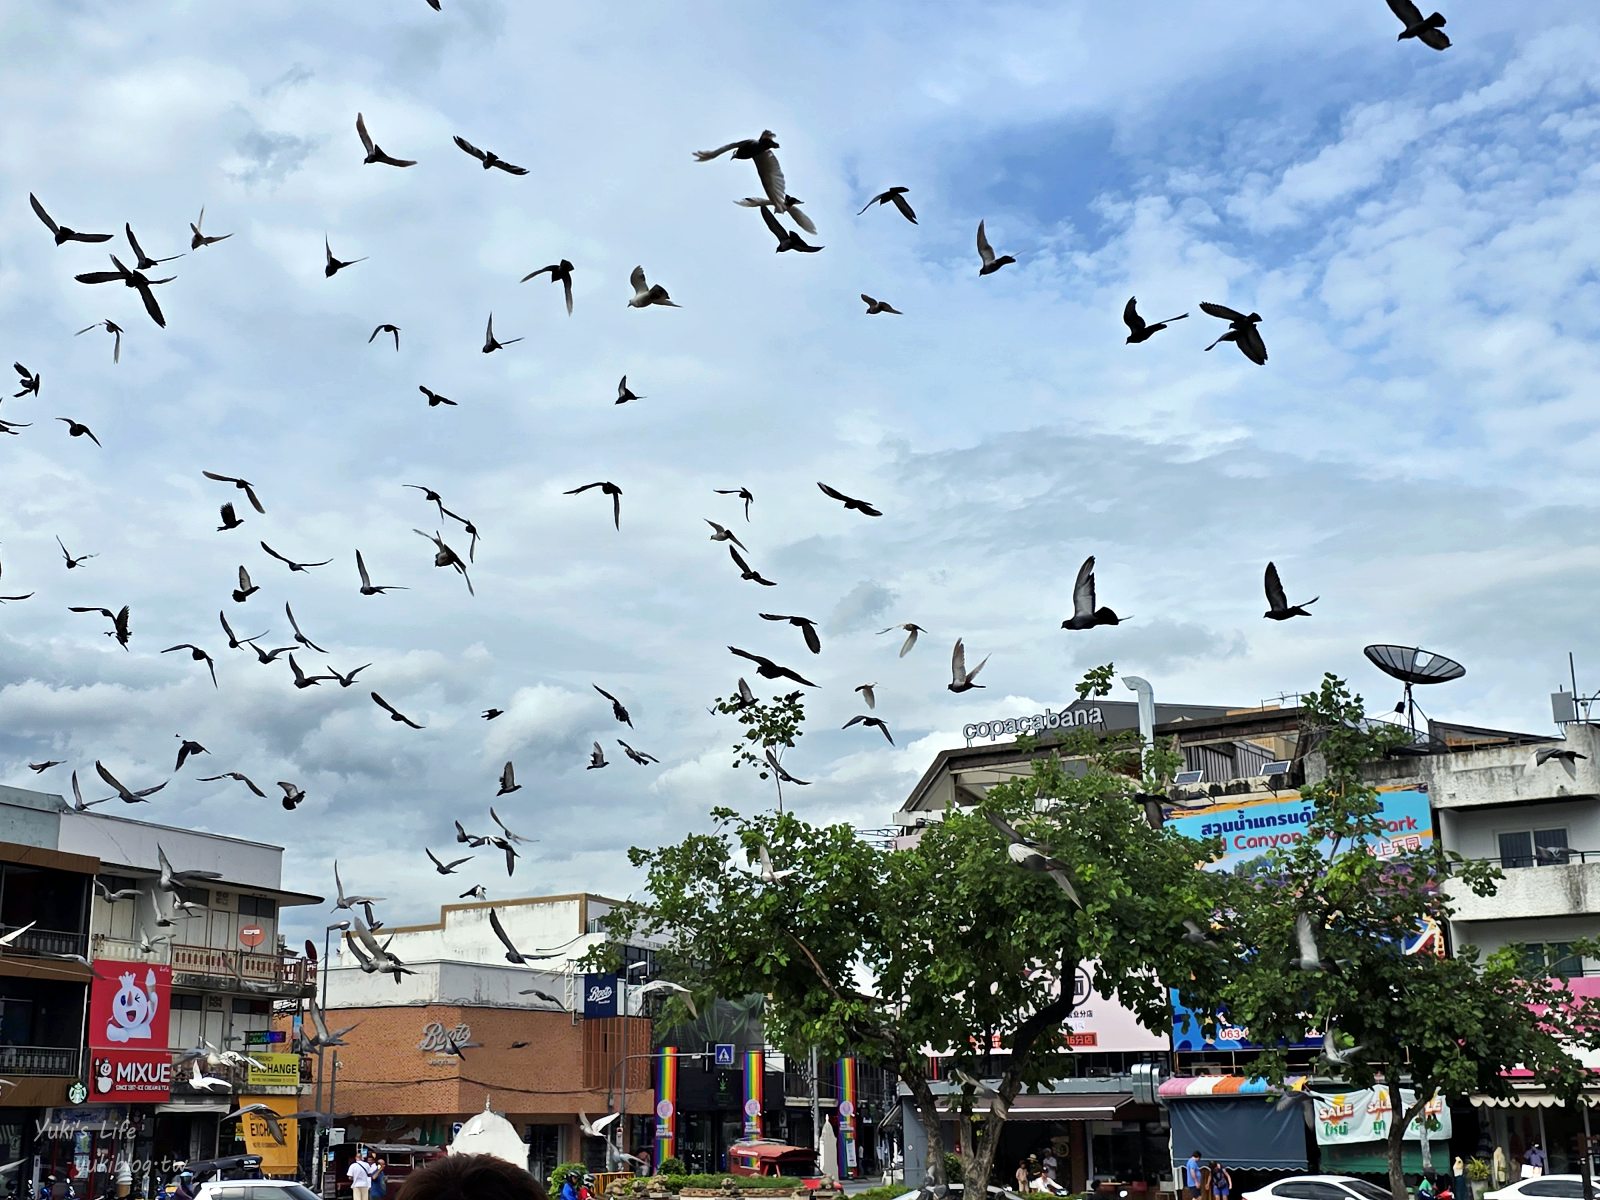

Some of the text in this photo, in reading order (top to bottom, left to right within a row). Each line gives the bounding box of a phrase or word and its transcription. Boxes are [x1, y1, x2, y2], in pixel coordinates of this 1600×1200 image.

[963, 707, 1103, 741] copacabana
[1234, 832, 1303, 850] Canyon
[587, 986, 612, 1002] Boots
[416, 1022, 471, 1051] Boots
[116, 1062, 171, 1083] MIXUE
[1319, 1104, 1353, 1120] SALE
